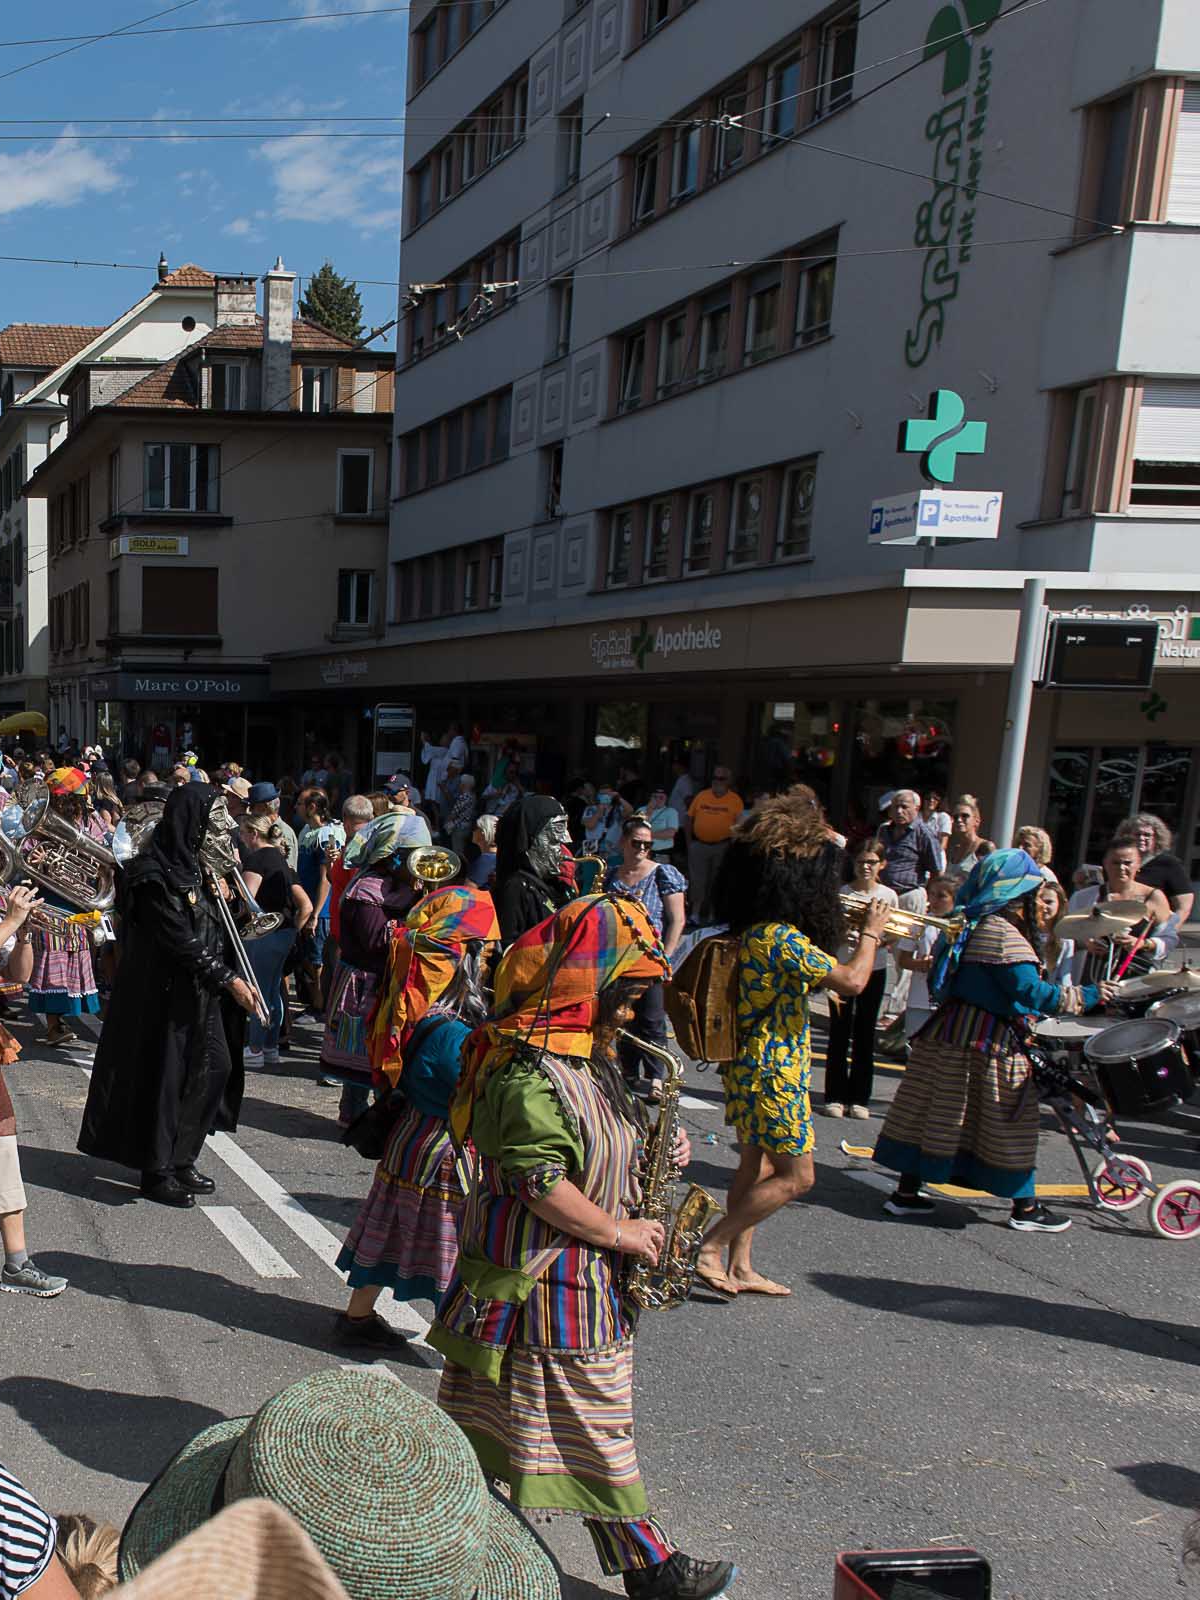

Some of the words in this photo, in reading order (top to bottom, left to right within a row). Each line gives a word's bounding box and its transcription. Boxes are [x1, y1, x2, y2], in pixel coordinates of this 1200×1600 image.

[967, 47, 992, 142] Natur
[871, 512, 881, 530] P
[922, 503, 938, 521] P
[943, 513, 989, 523] Apotheke
[655, 620, 721, 658] Apotheke
[135, 679, 180, 692] Marc
[185, 679, 241, 692] O'Polo
